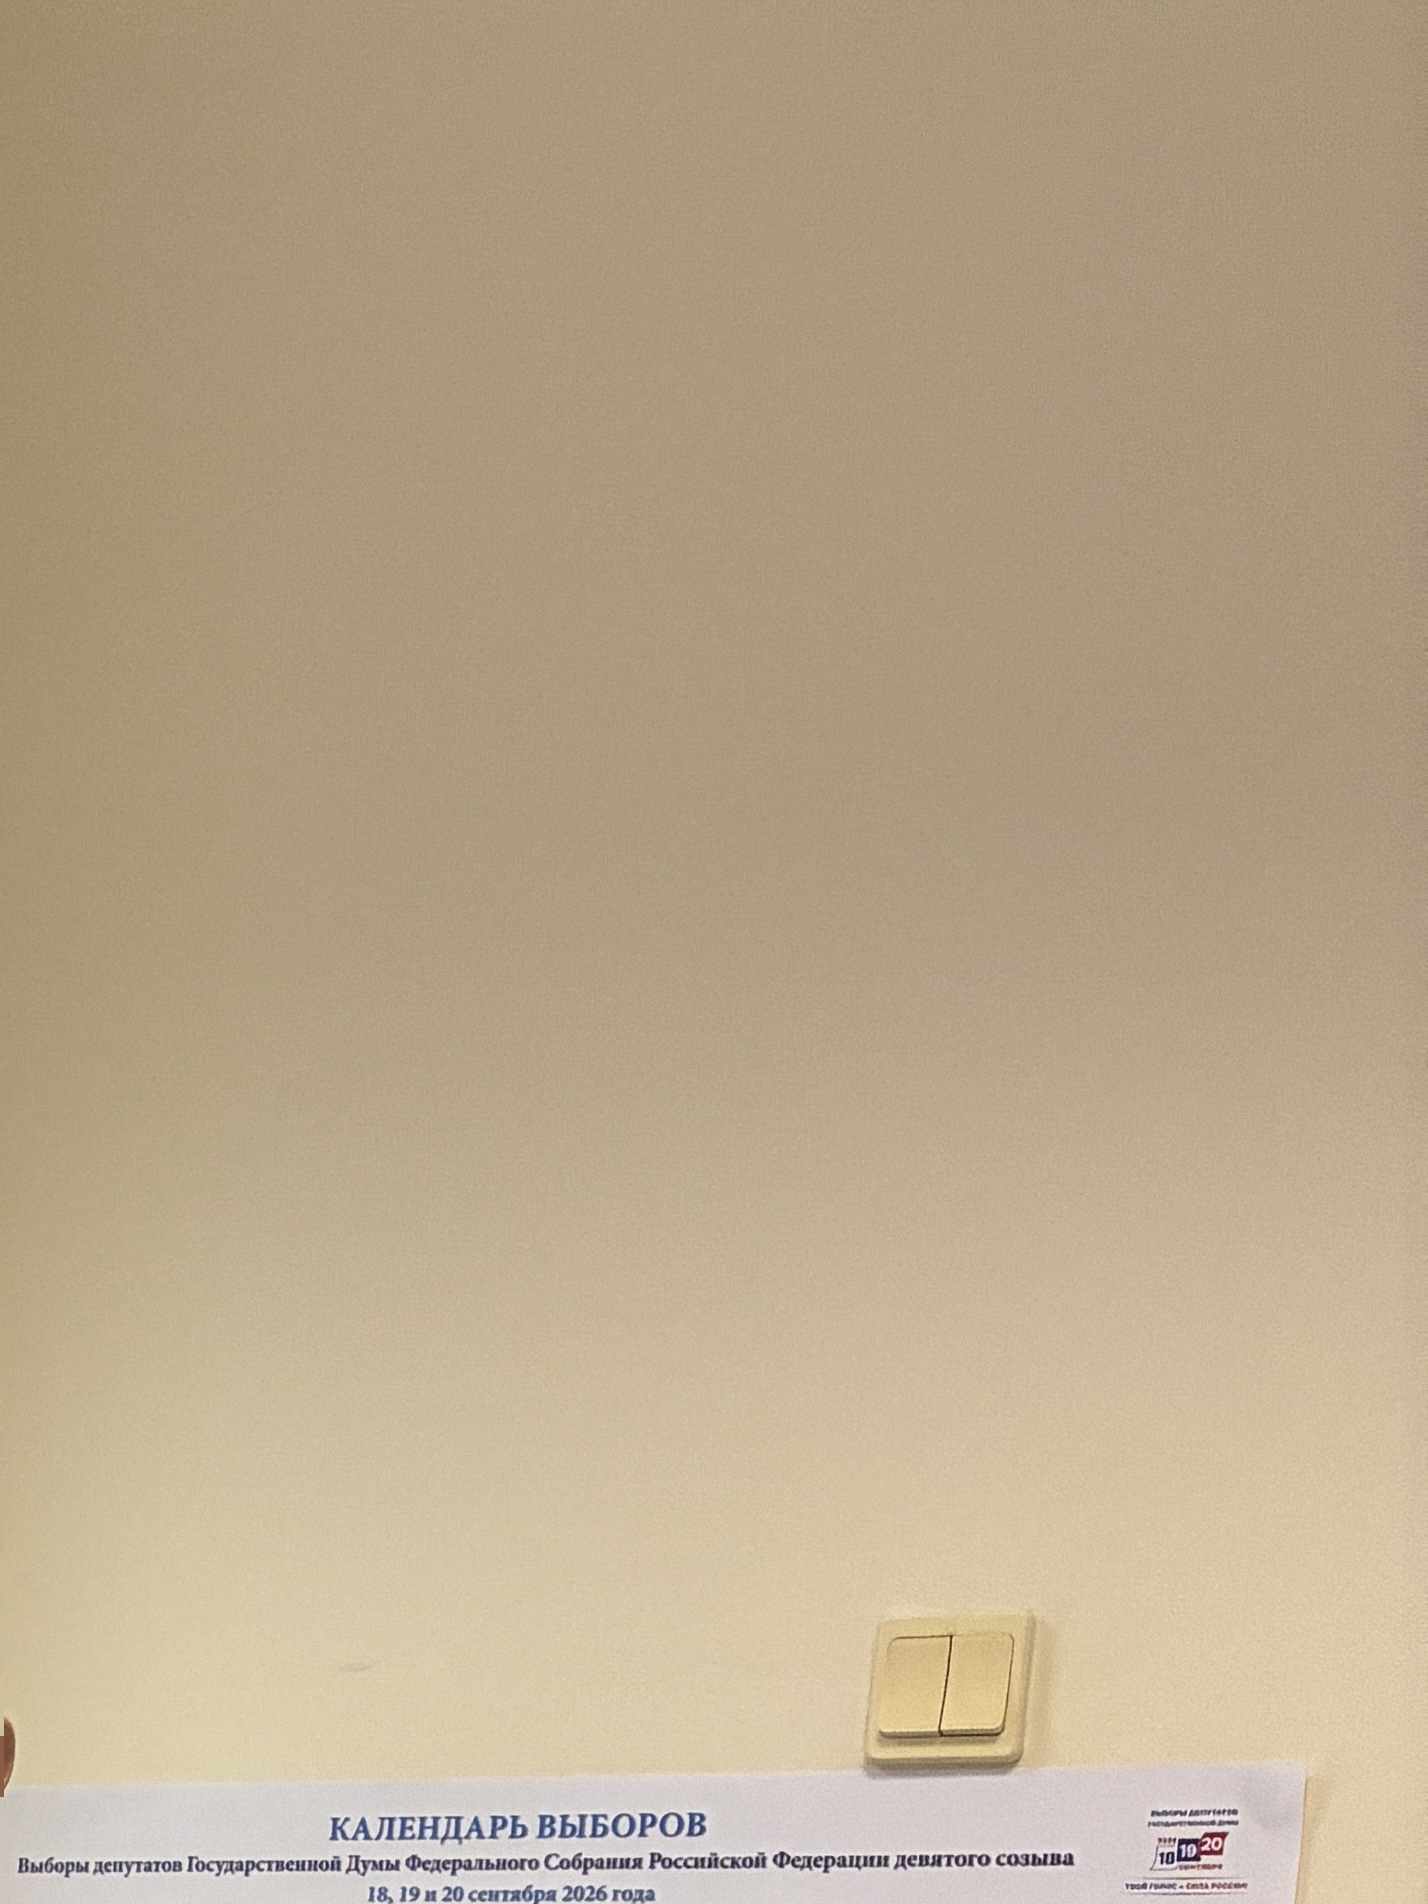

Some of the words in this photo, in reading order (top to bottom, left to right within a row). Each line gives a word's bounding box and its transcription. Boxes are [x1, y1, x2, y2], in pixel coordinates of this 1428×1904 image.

[329, 1815, 528, 1846] КАЛЕНДАРЬ
[535, 1812, 707, 1839] ВЫБОРОВ
[1180, 1844, 1196, 1858] 19
[1201, 1836, 1222, 1851] 20
[18, 1857, 89, 1878] Выборы
[92, 1861, 183, 1878] депутатов
[187, 1856, 342, 1877] Государственной
[345, 1855, 400, 1876] Думы
[405, 1854, 540, 1875] Федерального
[544, 1852, 643, 1874] Собрания
[648, 1852, 768, 1870] Российской
[772, 1851, 890, 1872] Федерации
[893, 1854, 991, 1871] девятого
[1007, 1853, 1075, 1867] созыва
[368, 1886, 394, 1904] 18,
[400, 1886, 420, 1903] 19
[424, 1890, 437, 1902] и
[442, 1886, 464, 1902] 20
[468, 1884, 557, 1904] сентября
[562, 1885, 608, 1902] 2026
[611, 1889, 656, 1904] года
